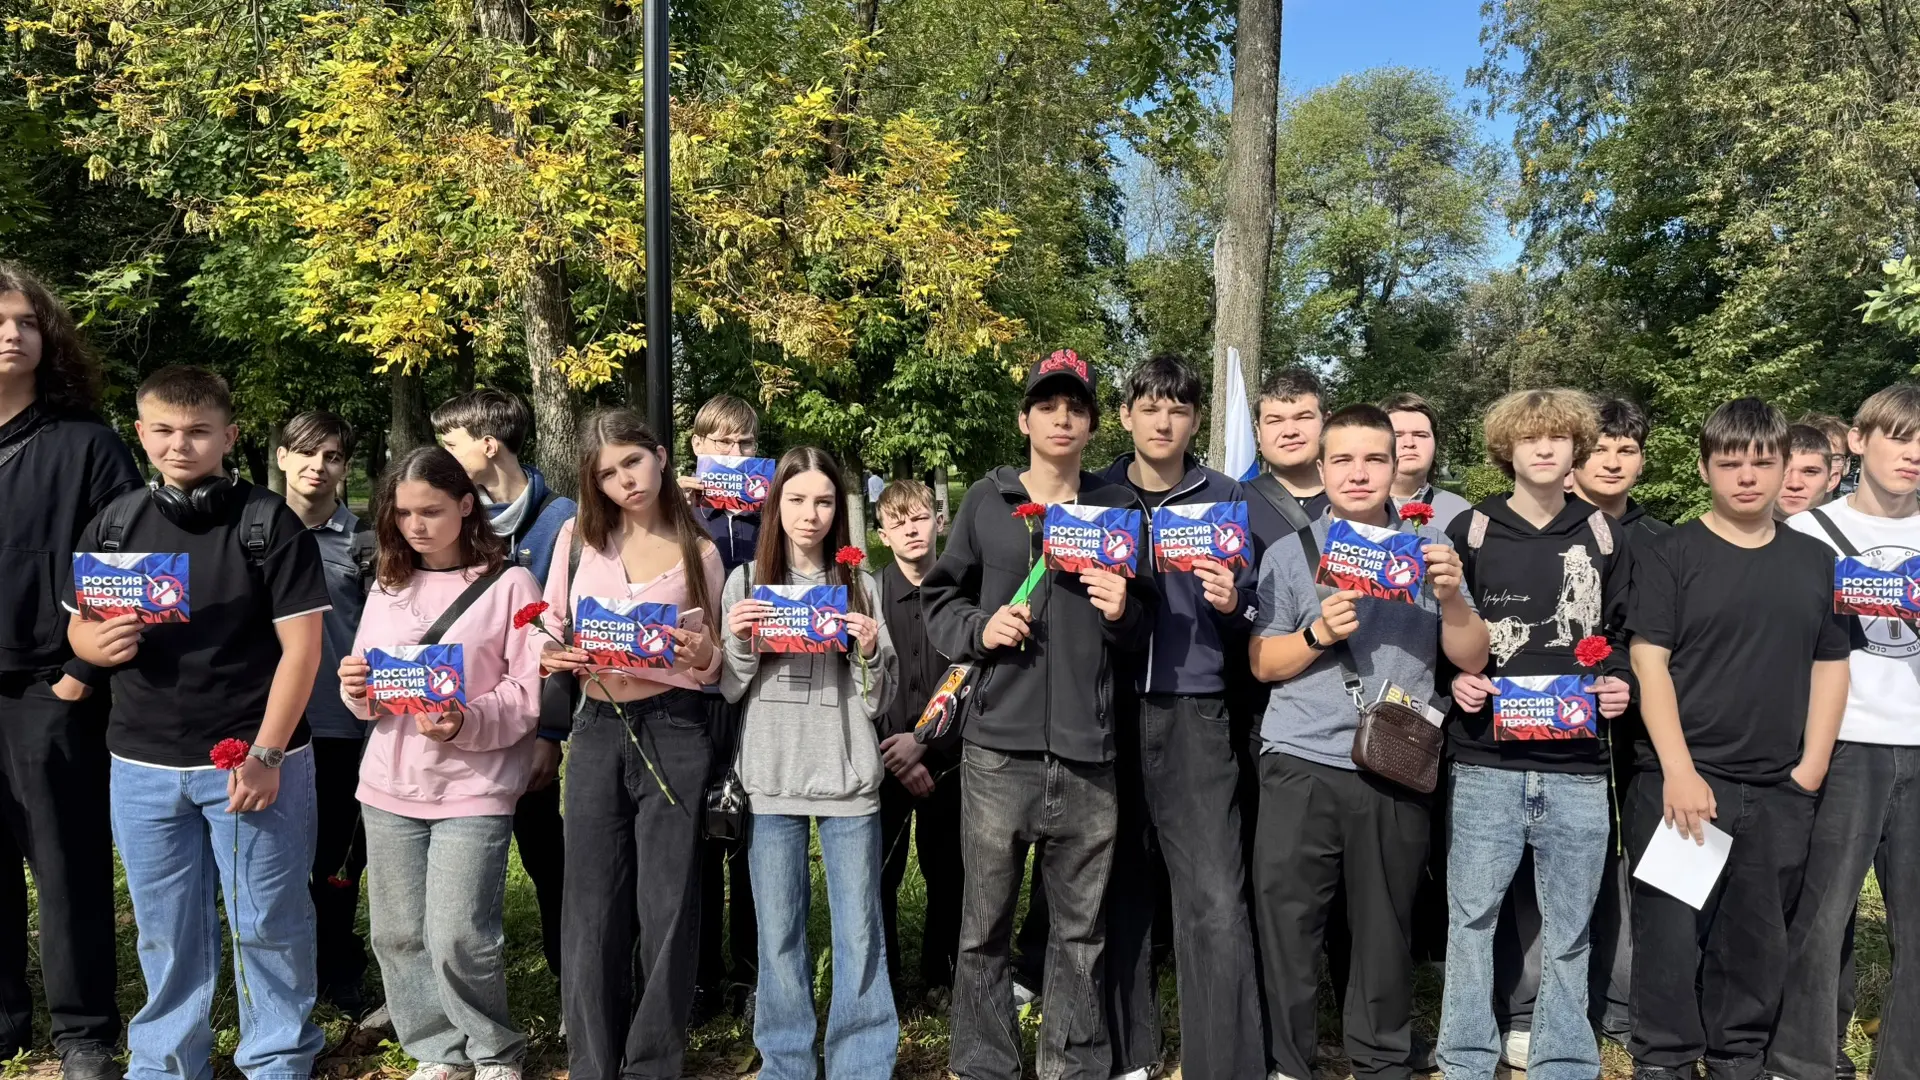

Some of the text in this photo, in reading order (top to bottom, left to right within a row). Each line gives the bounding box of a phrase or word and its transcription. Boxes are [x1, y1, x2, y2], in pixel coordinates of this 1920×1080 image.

[700, 472, 743, 482] РОССИЯ
[1049, 525, 1100, 538] РОССИЯ
[1160, 525, 1211, 537] РОССИЯ
[1049, 536, 1100, 548] ПРОТИВ
[1160, 536, 1212, 548] ПРОТИВ
[1048, 546, 1099, 559] ТЕРРОРА
[1161, 546, 1213, 558] ТЕРРОРА
[1331, 540, 1386, 561] РОССИЯ
[1328, 551, 1383, 571] ПРОТИВ
[1326, 561, 1378, 580] ТЕРРОРА
[82, 576, 142, 586] РОССИЯ
[1841, 577, 1903, 587] РОССИЯ
[83, 587, 143, 597] ПРОТИВ
[1841, 587, 1904, 597] ПРОТИВ
[83, 597, 142, 607] ТЕРРОРА
[1841, 595, 1902, 606] ТЕРРОРА
[772, 607, 809, 617] ССИЯ
[581, 618, 635, 632] РОССИЯ
[758, 617, 809, 627] ПРОТИВ
[580, 629, 634, 642] ПРОТИВ
[758, 627, 809, 637] ТЕРРОРА
[579, 640, 633, 652] ТЕРРОРА
[373, 667, 425, 679] РОССИЯ
[373, 678, 426, 689] ПРОТИВ
[373, 689, 427, 700] ТЕРРОРА
[1500, 697, 1554, 708] РОССИЯ
[1500, 708, 1555, 718] ПРОТИВ
[1500, 717, 1554, 727] ТЕРРОРА
